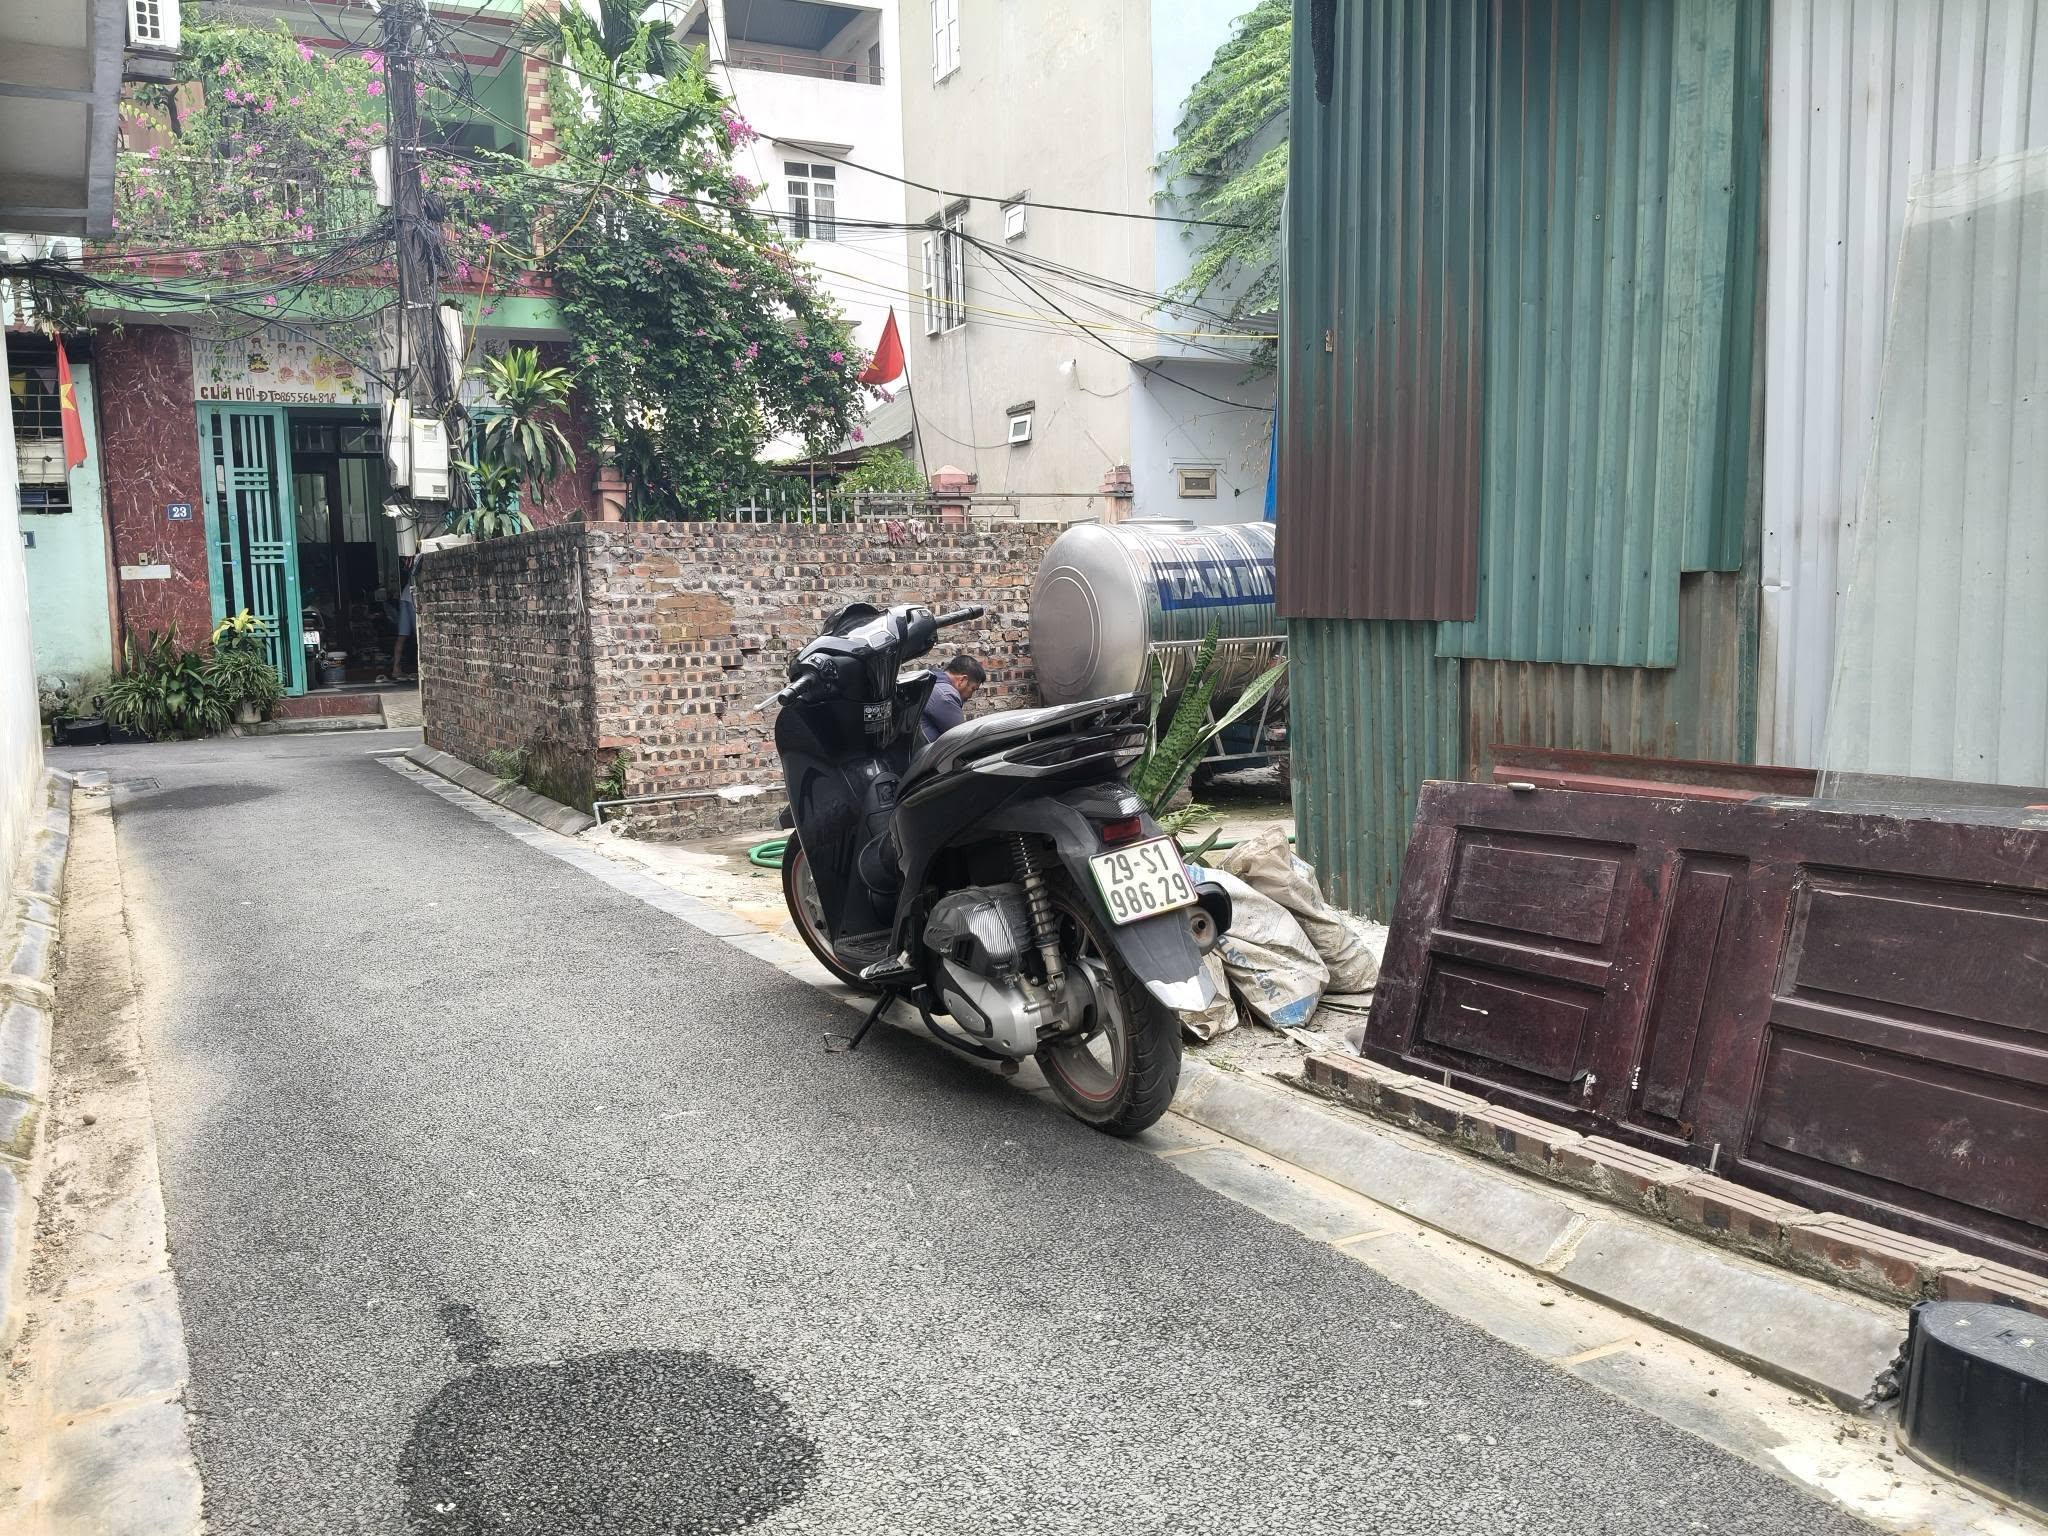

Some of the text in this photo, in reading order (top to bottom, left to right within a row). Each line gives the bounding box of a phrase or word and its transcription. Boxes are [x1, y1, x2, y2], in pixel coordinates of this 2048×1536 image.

[172, 506, 187, 518] 23
[1103, 843, 1169, 886] 29-S1
[1110, 872, 1190, 918] 986.29
